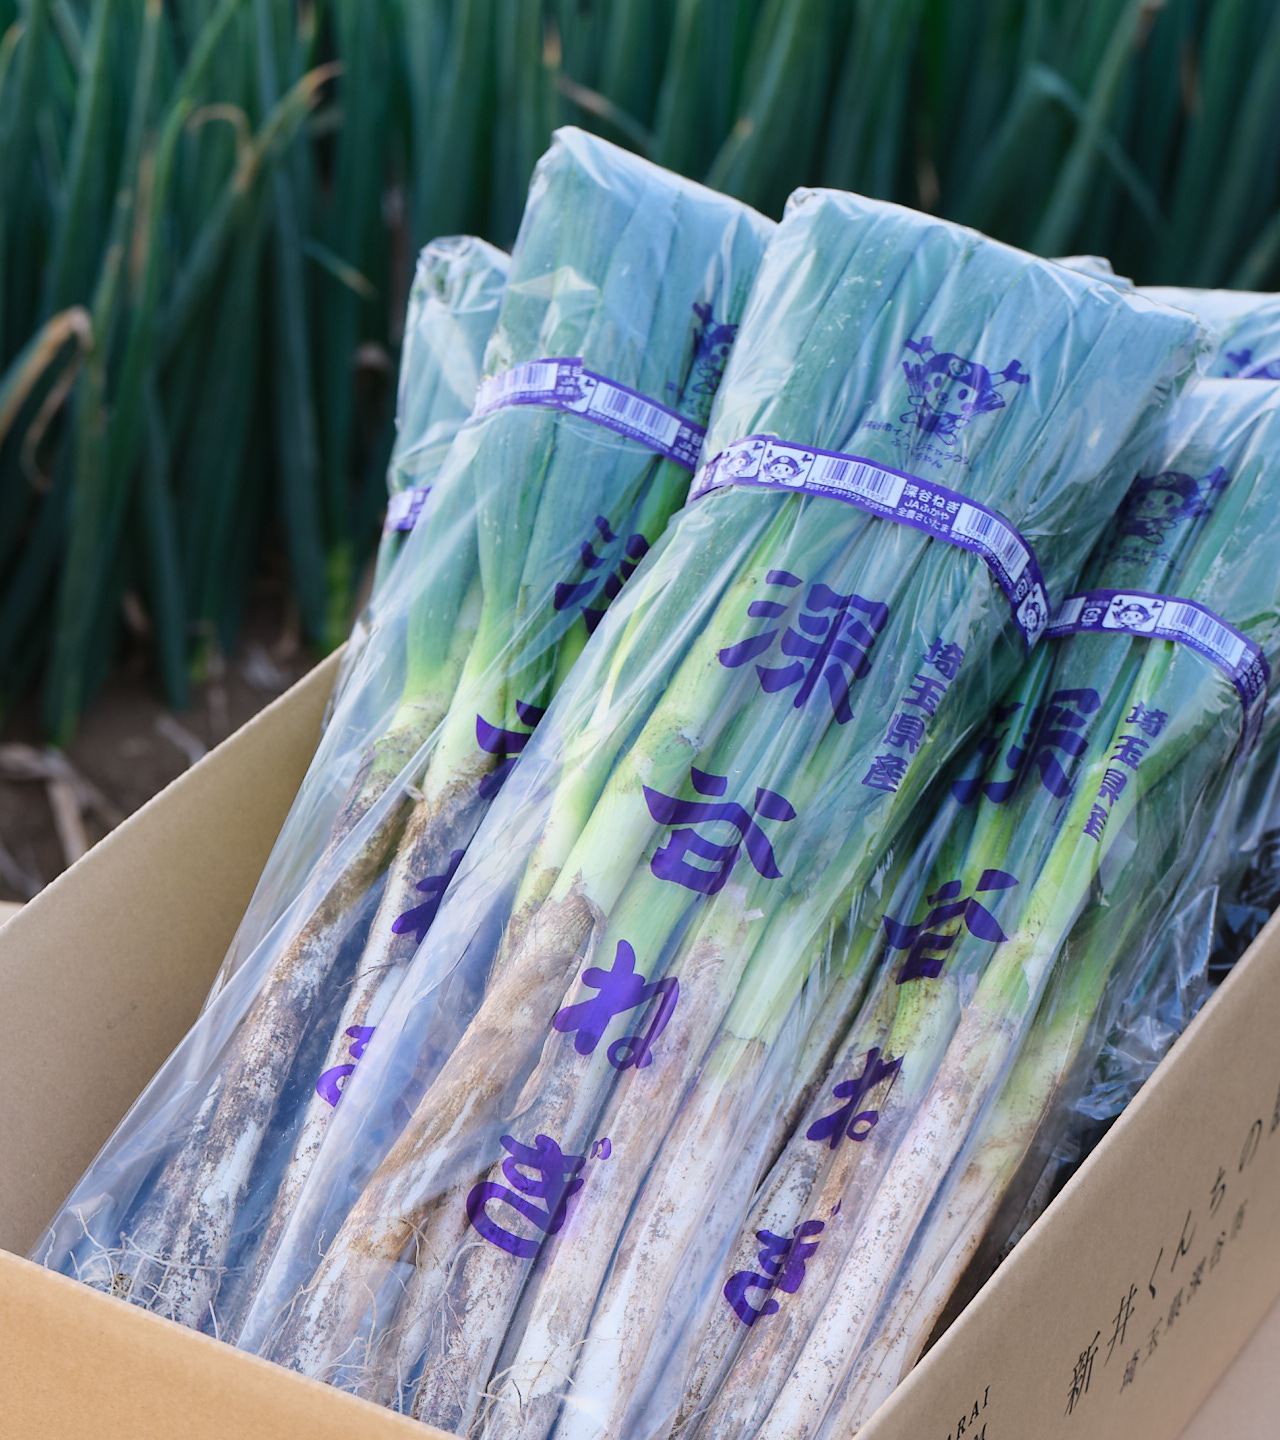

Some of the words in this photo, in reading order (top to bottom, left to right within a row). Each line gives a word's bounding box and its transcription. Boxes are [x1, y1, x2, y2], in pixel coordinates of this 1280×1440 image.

[904, 483, 960, 514] 深谷ねぎ
[904, 500, 950, 521] JAふかや
[861, 636, 964, 796] 埼玉県産
[466, 568, 889, 1259] 深谷ねぎ
